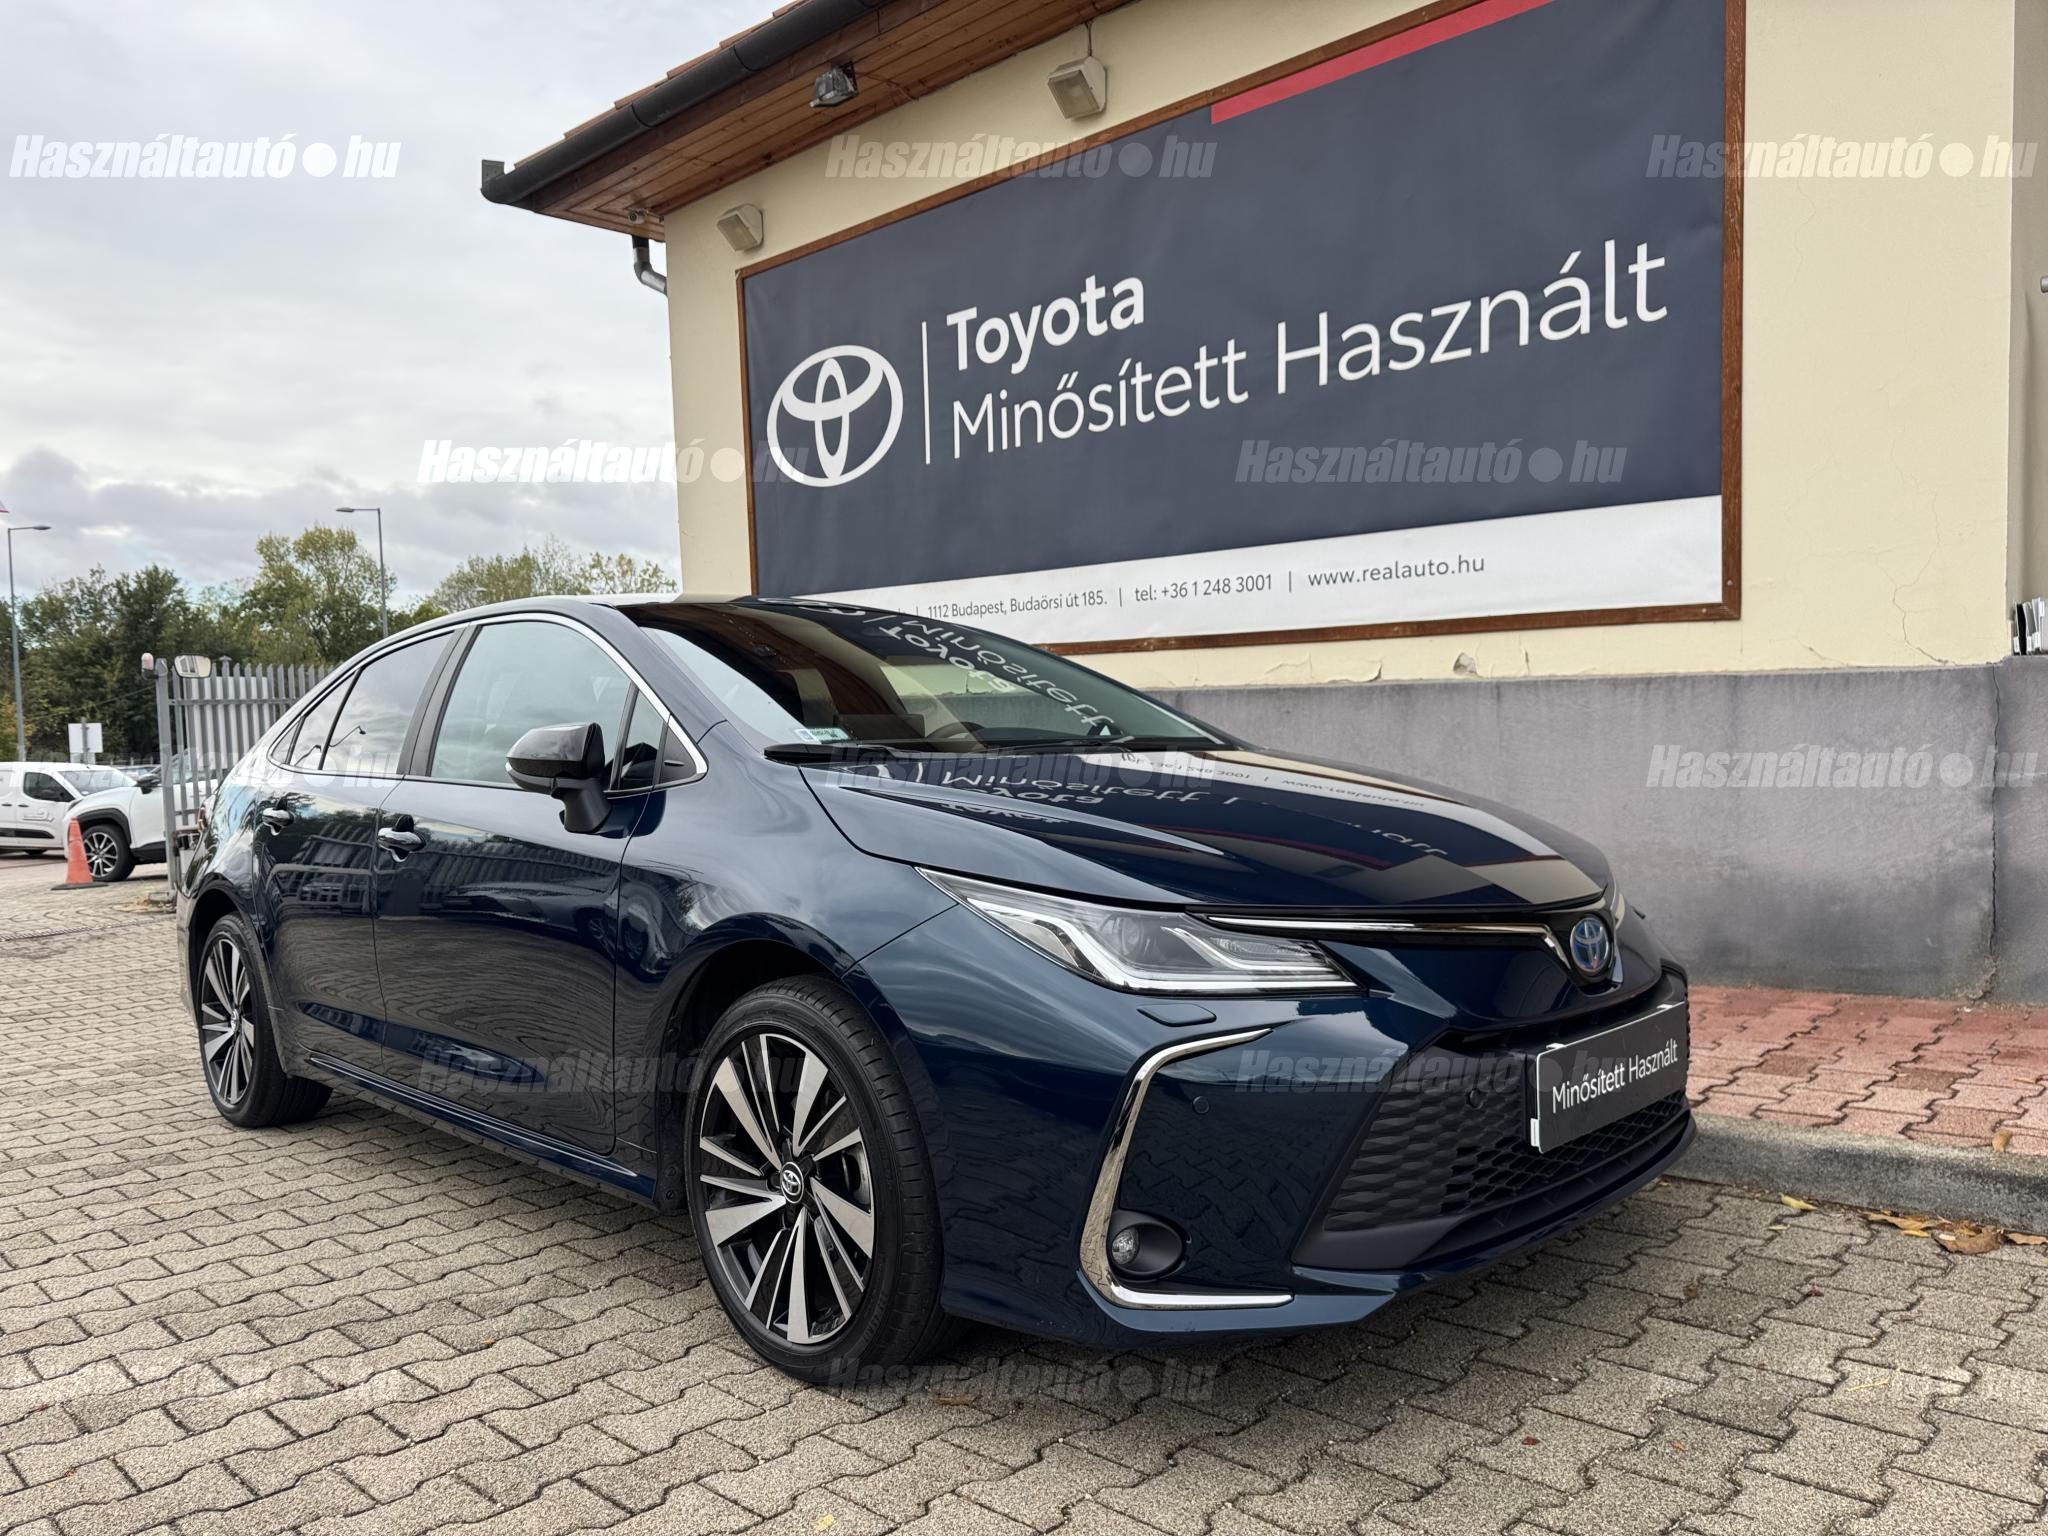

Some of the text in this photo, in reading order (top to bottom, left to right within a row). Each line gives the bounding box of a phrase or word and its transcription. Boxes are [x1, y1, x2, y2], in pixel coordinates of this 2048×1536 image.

[947, 275, 1145, 374] Toyota
[953, 239, 1668, 459] Minősített Használt
[951, 599, 1007, 620] Budapest,
[1010, 593, 1063, 613] Budaörsi
[1065, 594, 1079, 608] út
[1082, 590, 1107, 606] 185.
[1134, 584, 1158, 602] tel:
[1161, 581, 1188, 598] +36
[1202, 577, 1232, 596] 248
[1235, 574, 1272, 593] 3001
[1308, 554, 1485, 587] www.realauto.hu
[1552, 1038, 1679, 1114] Minősített Használt
